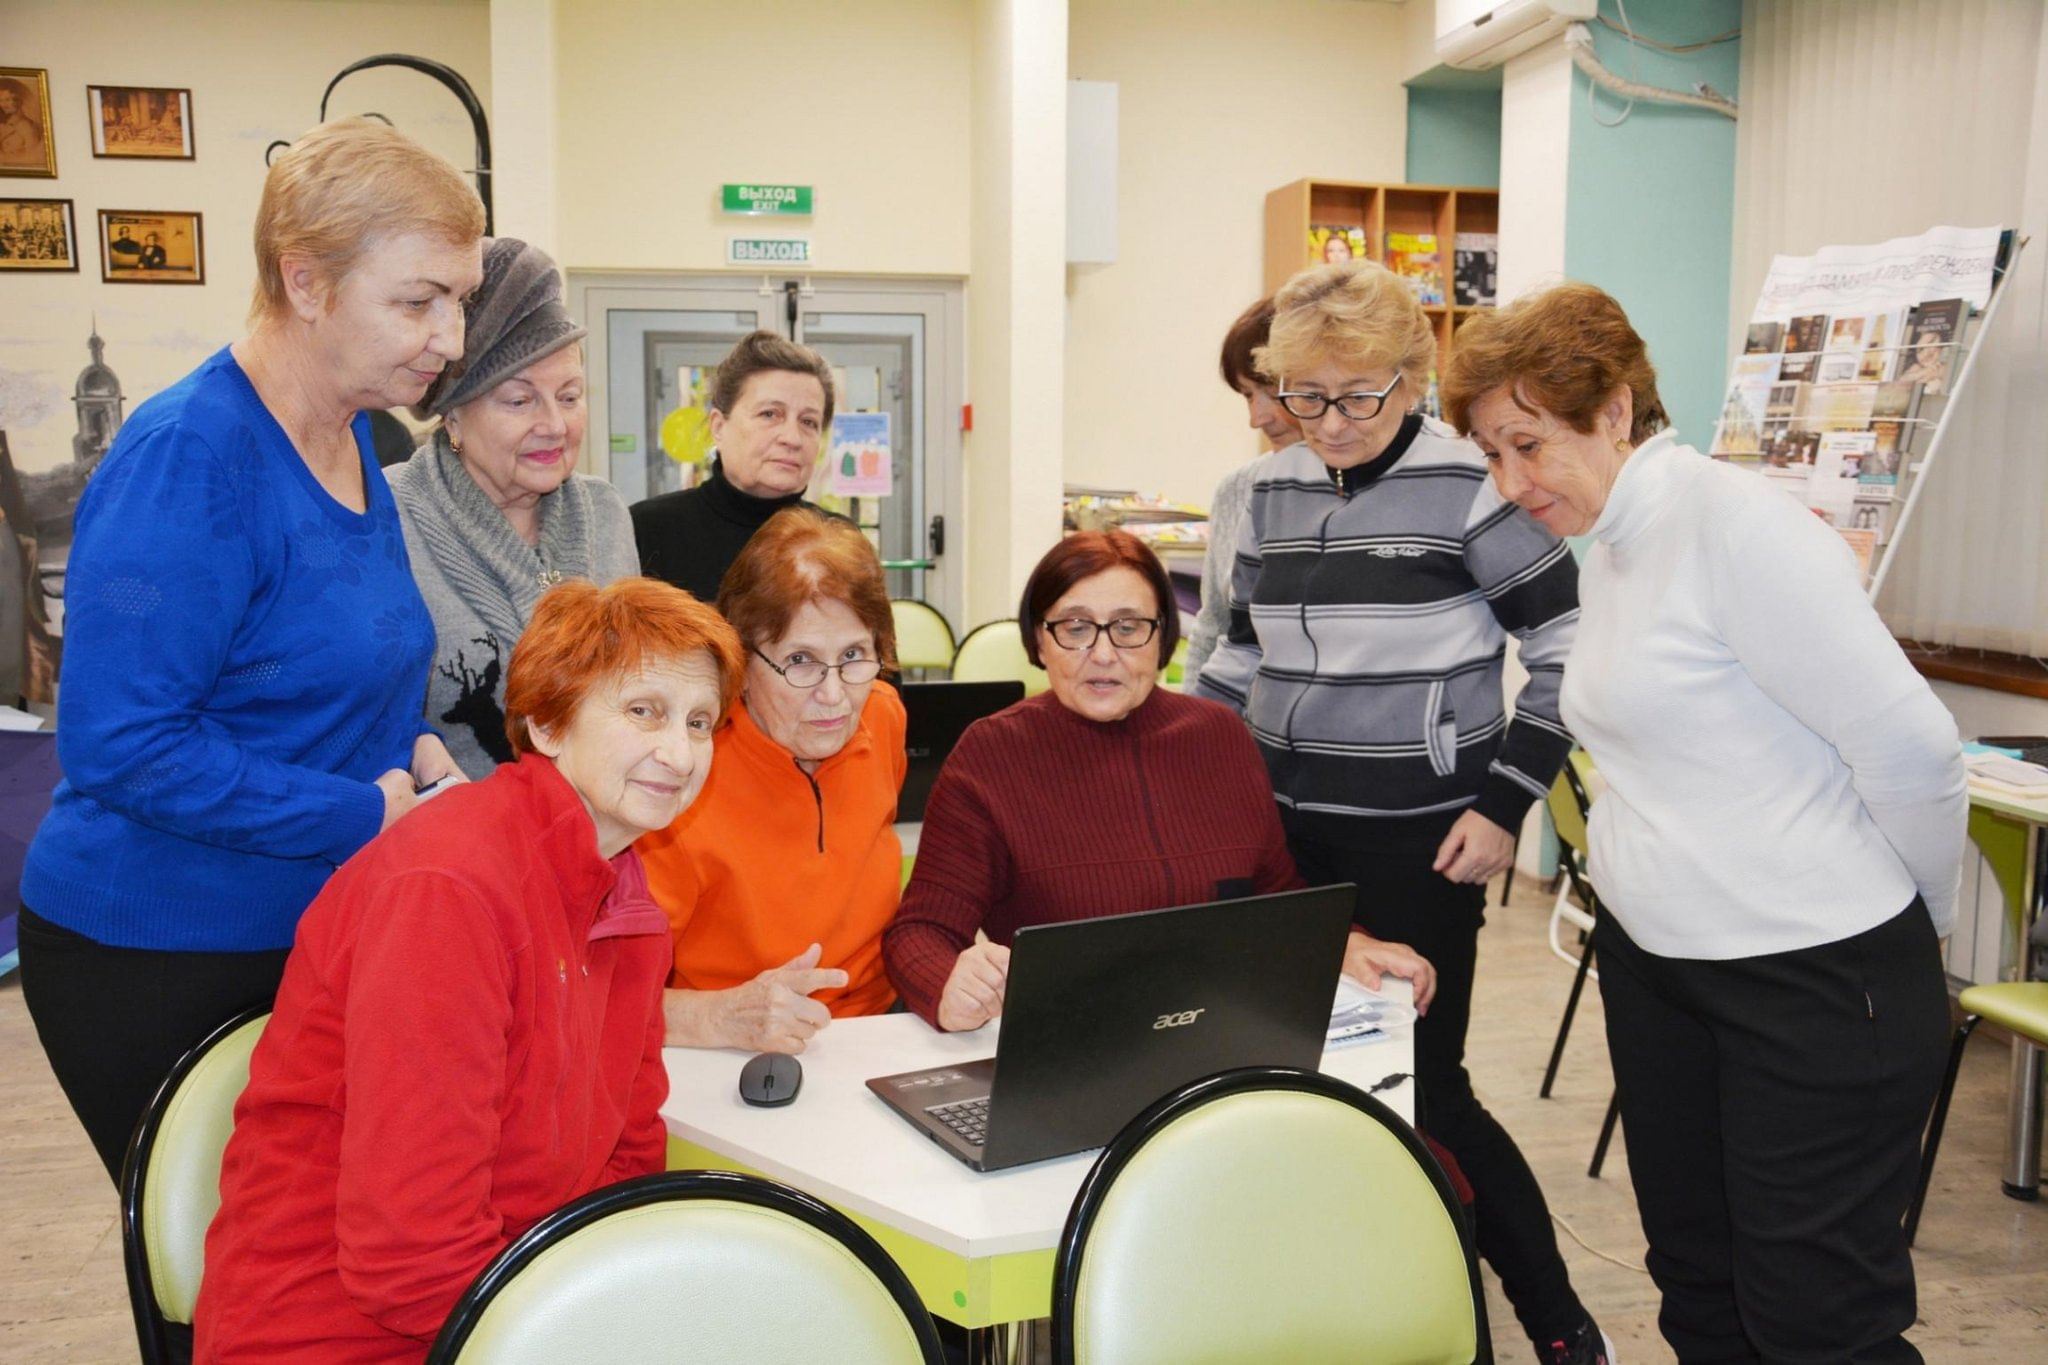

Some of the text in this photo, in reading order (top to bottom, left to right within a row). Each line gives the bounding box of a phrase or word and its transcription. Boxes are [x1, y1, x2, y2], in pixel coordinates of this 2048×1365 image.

[739, 187, 797, 203] ВЫХОД
[735, 241, 805, 259] ВЫХОД
[1152, 1008, 1206, 1030] acer
